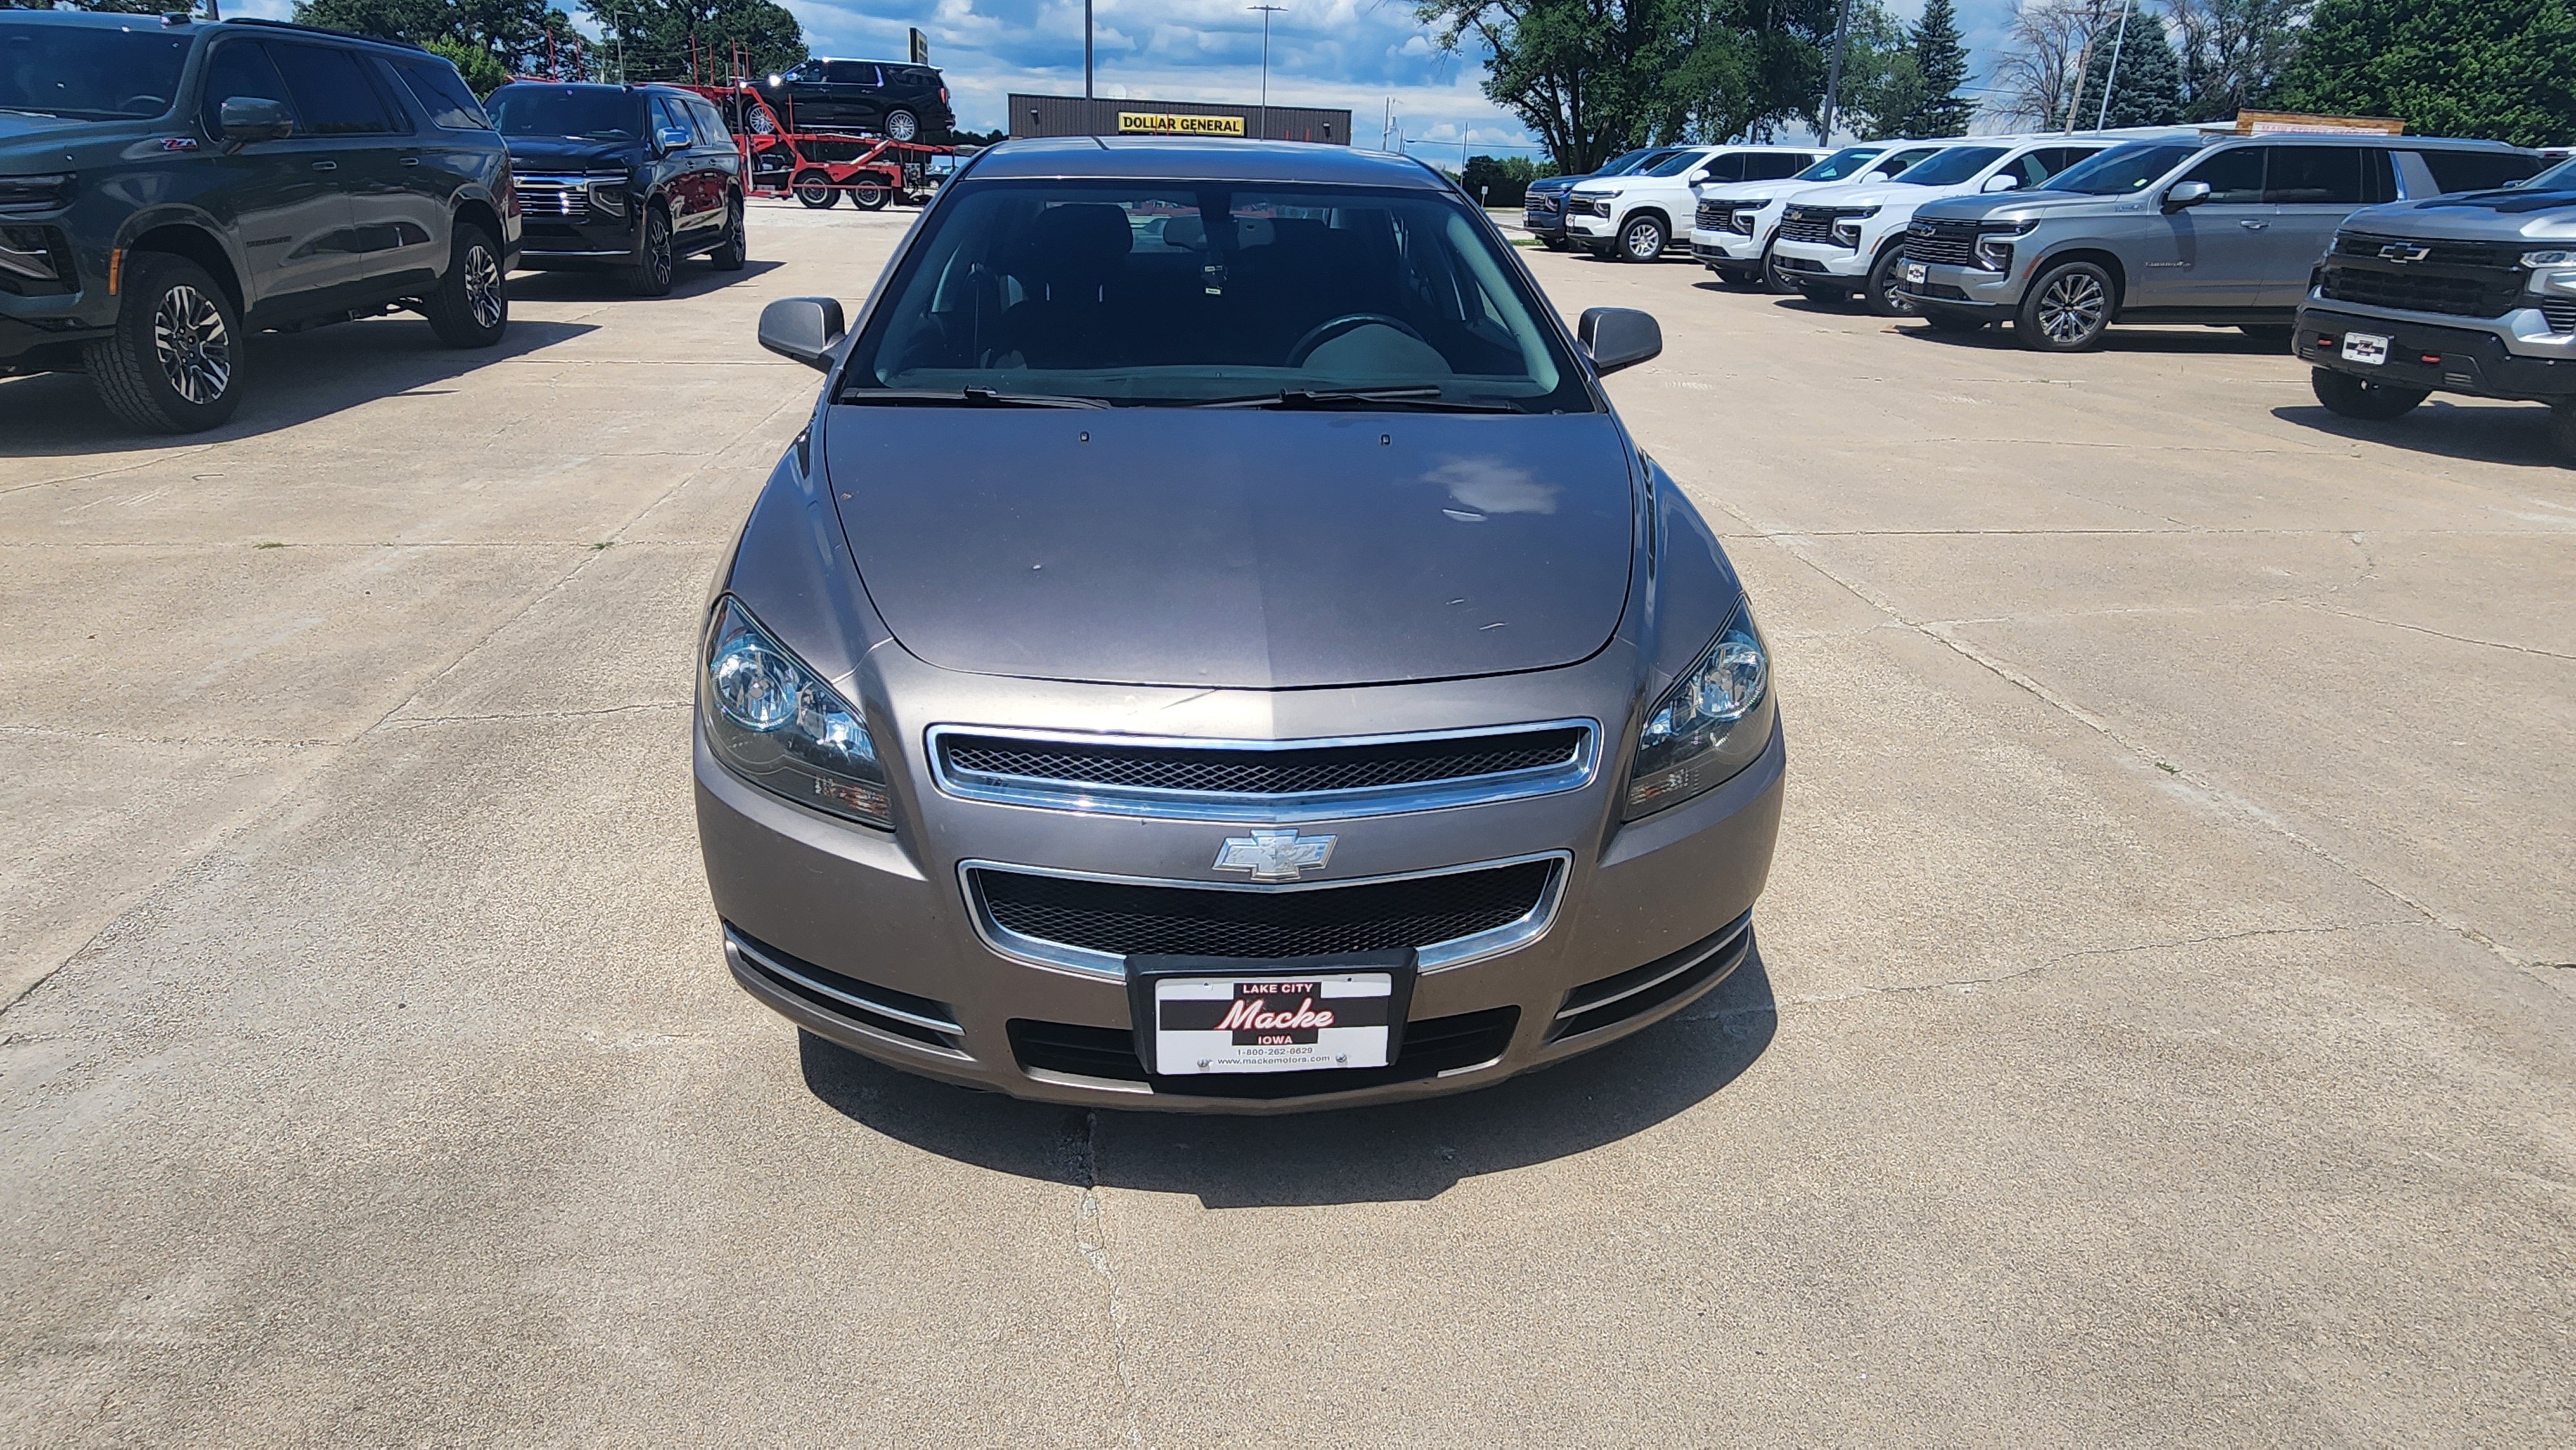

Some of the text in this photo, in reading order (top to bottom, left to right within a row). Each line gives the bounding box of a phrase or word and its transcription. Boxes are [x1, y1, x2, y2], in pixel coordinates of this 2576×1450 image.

[1123, 116, 1240, 132] DOLLAR GENERAL
[1242, 983, 1313, 994] LAKE CITY
[1214, 997, 1335, 1031] Macke
[1258, 1035, 1293, 1045] IOWA
[1217, 1055, 1331, 1065] www.mackemotors.com
